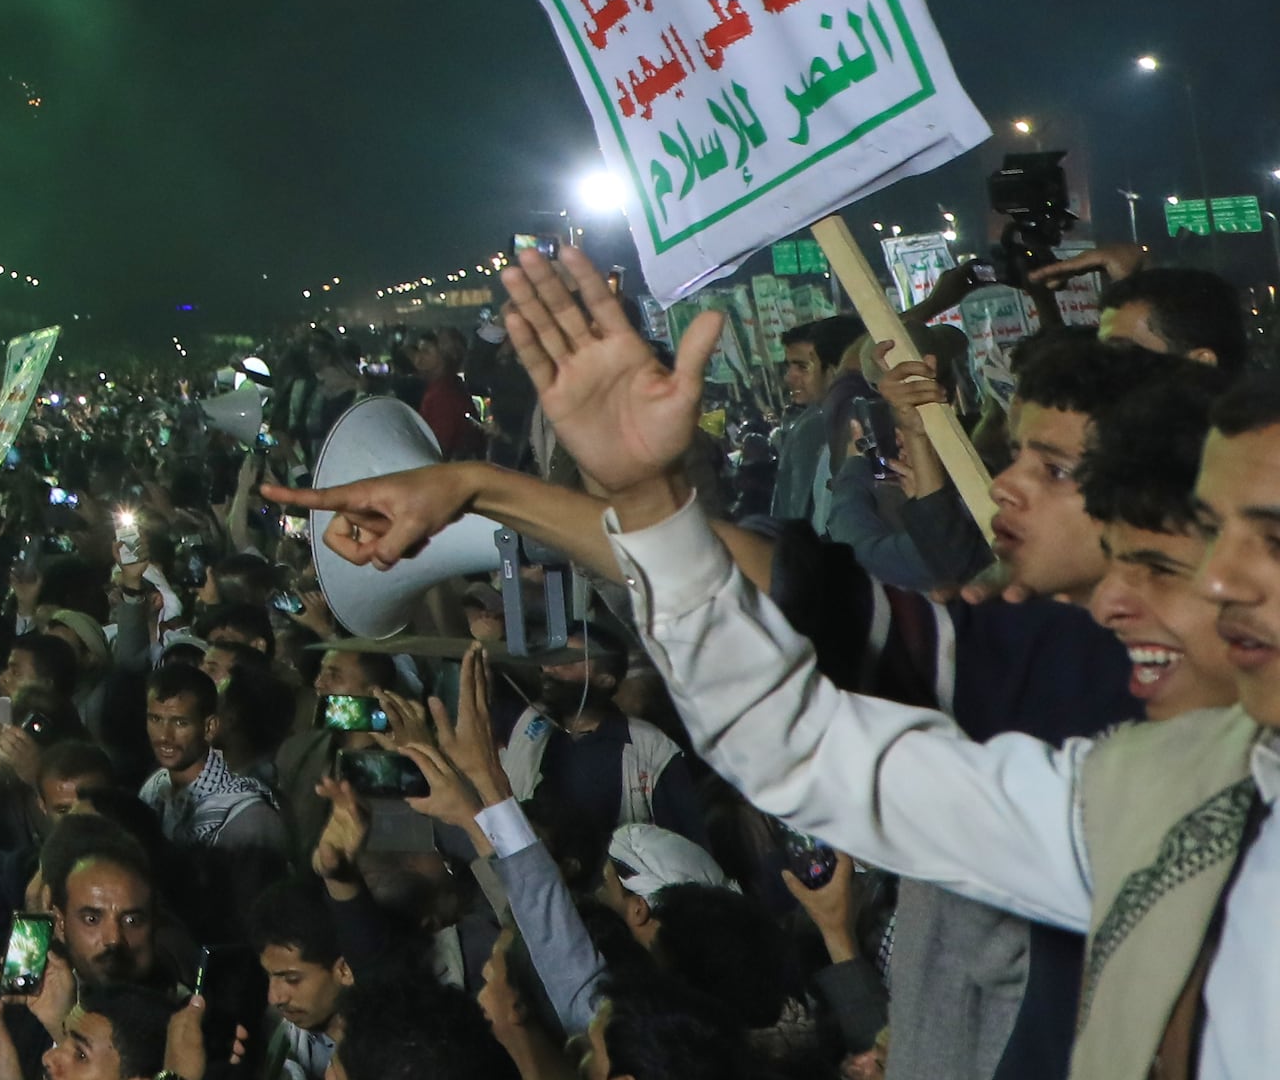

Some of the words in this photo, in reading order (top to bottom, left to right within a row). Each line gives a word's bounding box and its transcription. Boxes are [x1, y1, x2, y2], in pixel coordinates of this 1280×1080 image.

[616, 24, 695, 119] اليهود
[779, 0, 893, 145] النصر
[650, 81, 767, 224] للإسلام
